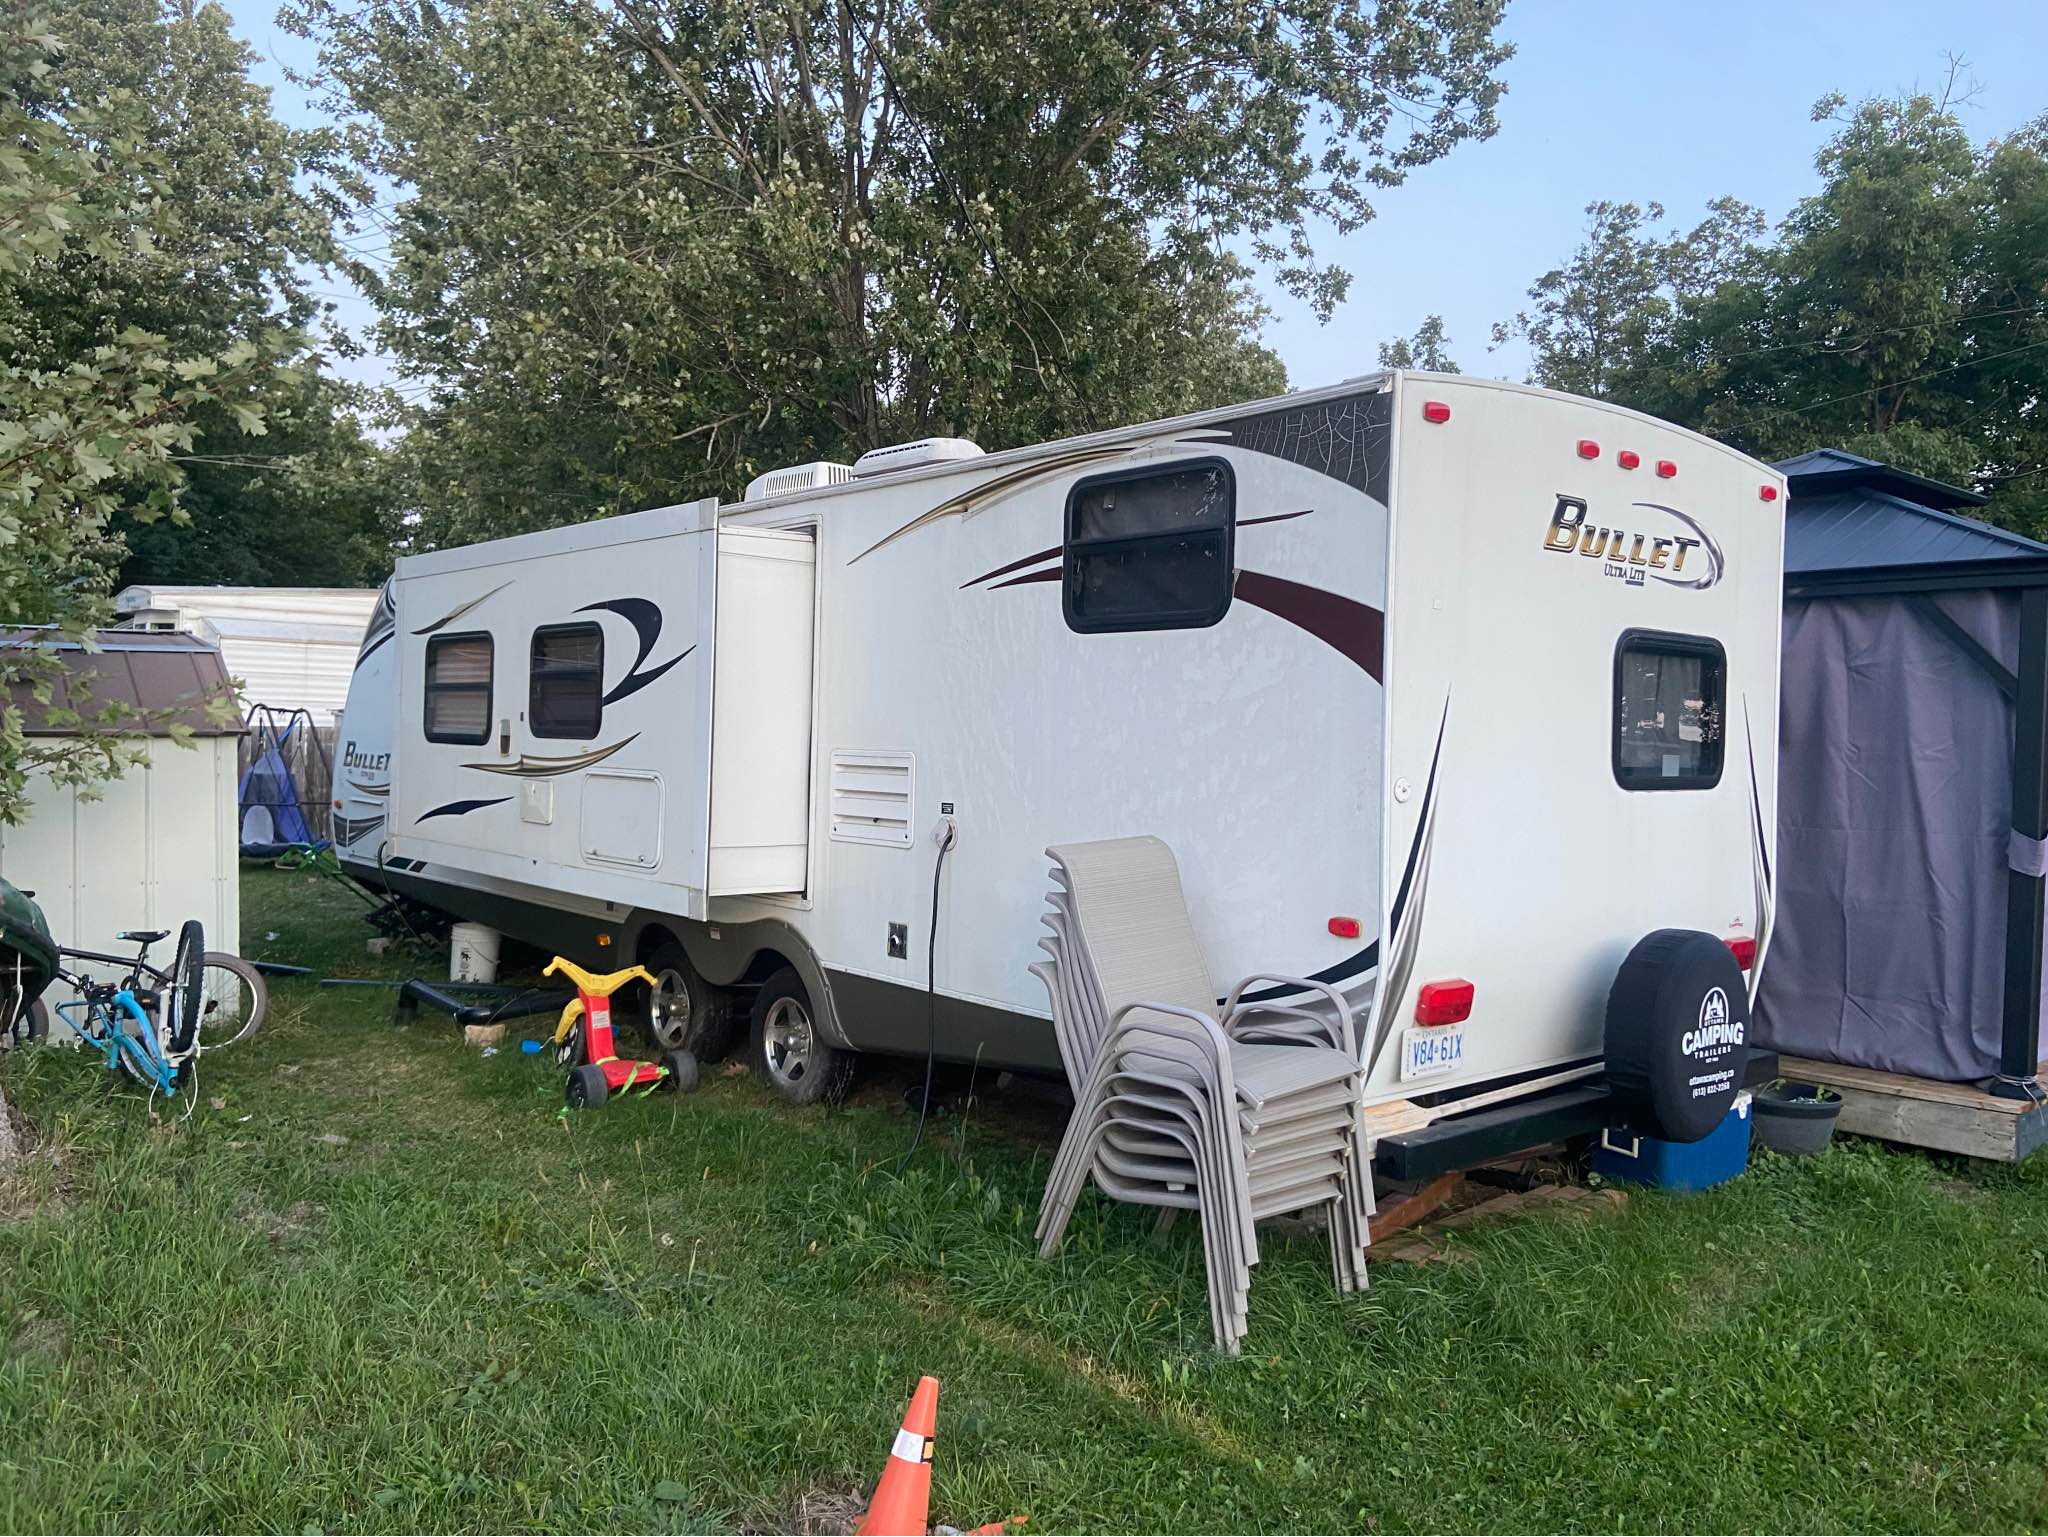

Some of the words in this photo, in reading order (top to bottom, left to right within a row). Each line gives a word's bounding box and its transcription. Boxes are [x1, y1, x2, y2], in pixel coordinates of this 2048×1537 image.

[1543, 493, 1700, 572] BULLET
[1604, 563, 1628, 579] ULTRA
[1629, 567, 1646, 581] LITE
[343, 740, 391, 771] BULLET
[1682, 1022, 1744, 1055] CAMPING
[1694, 1045, 1731, 1059] TRAILERS
[1692, 1087, 1706, 1099] (613)
